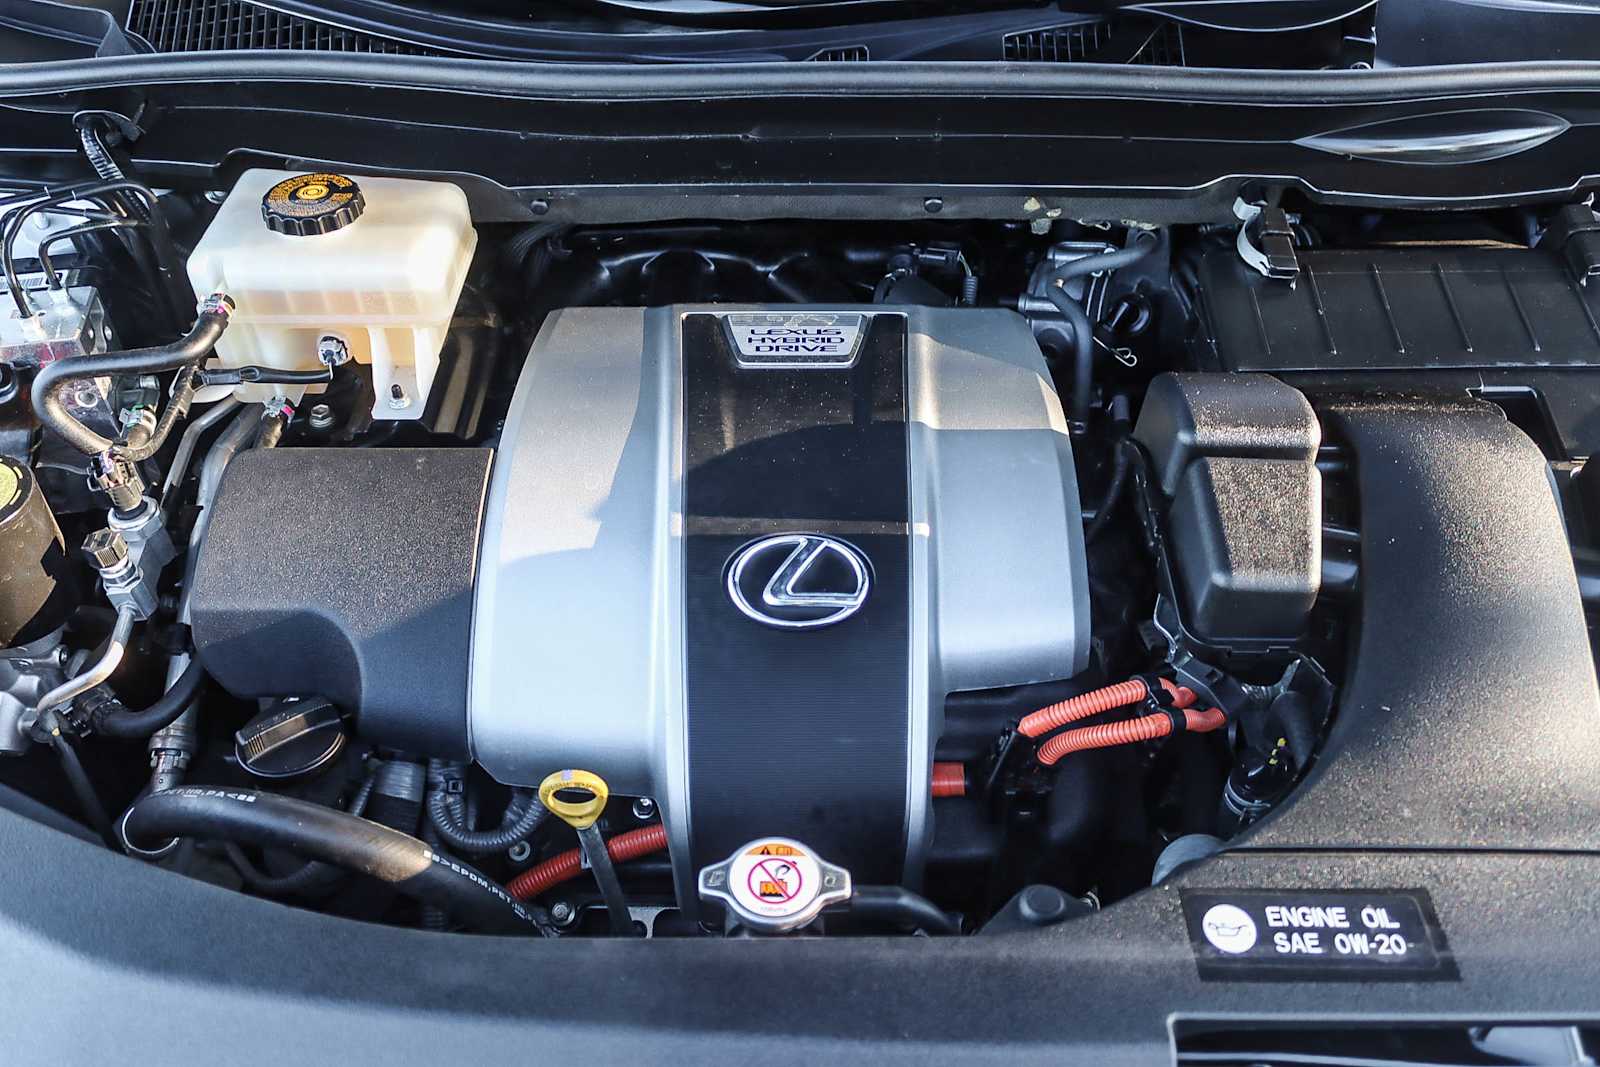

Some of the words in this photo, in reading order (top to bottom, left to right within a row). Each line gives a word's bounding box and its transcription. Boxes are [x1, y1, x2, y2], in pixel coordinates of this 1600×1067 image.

[1265, 906, 1350, 928] ENGINE
[1361, 908, 1401, 929] OIL
[1273, 932, 1324, 954] SAE
